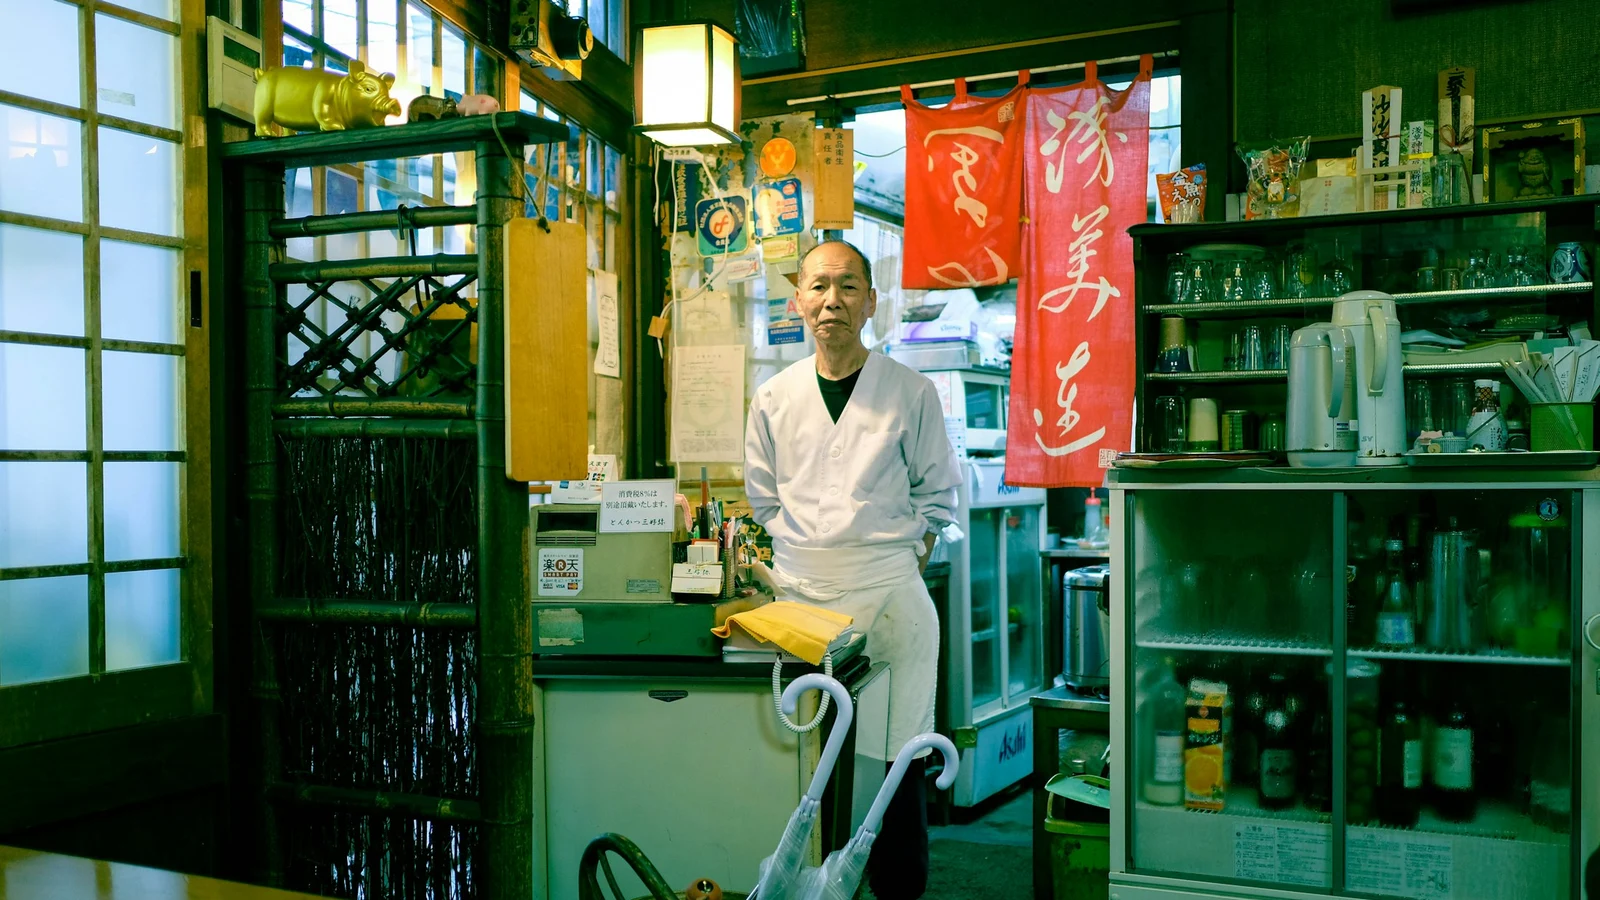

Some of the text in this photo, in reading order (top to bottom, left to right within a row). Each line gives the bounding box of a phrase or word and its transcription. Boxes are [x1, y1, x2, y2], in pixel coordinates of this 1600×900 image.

[823, 132, 832, 165] 責任者
[835, 132, 844, 165] 食品衛生
[605, 501, 668, 509] 別途頂戴いたします。
[618, 490, 658, 498] 消費税8%は
[998, 721, 1027, 765] Asahi
